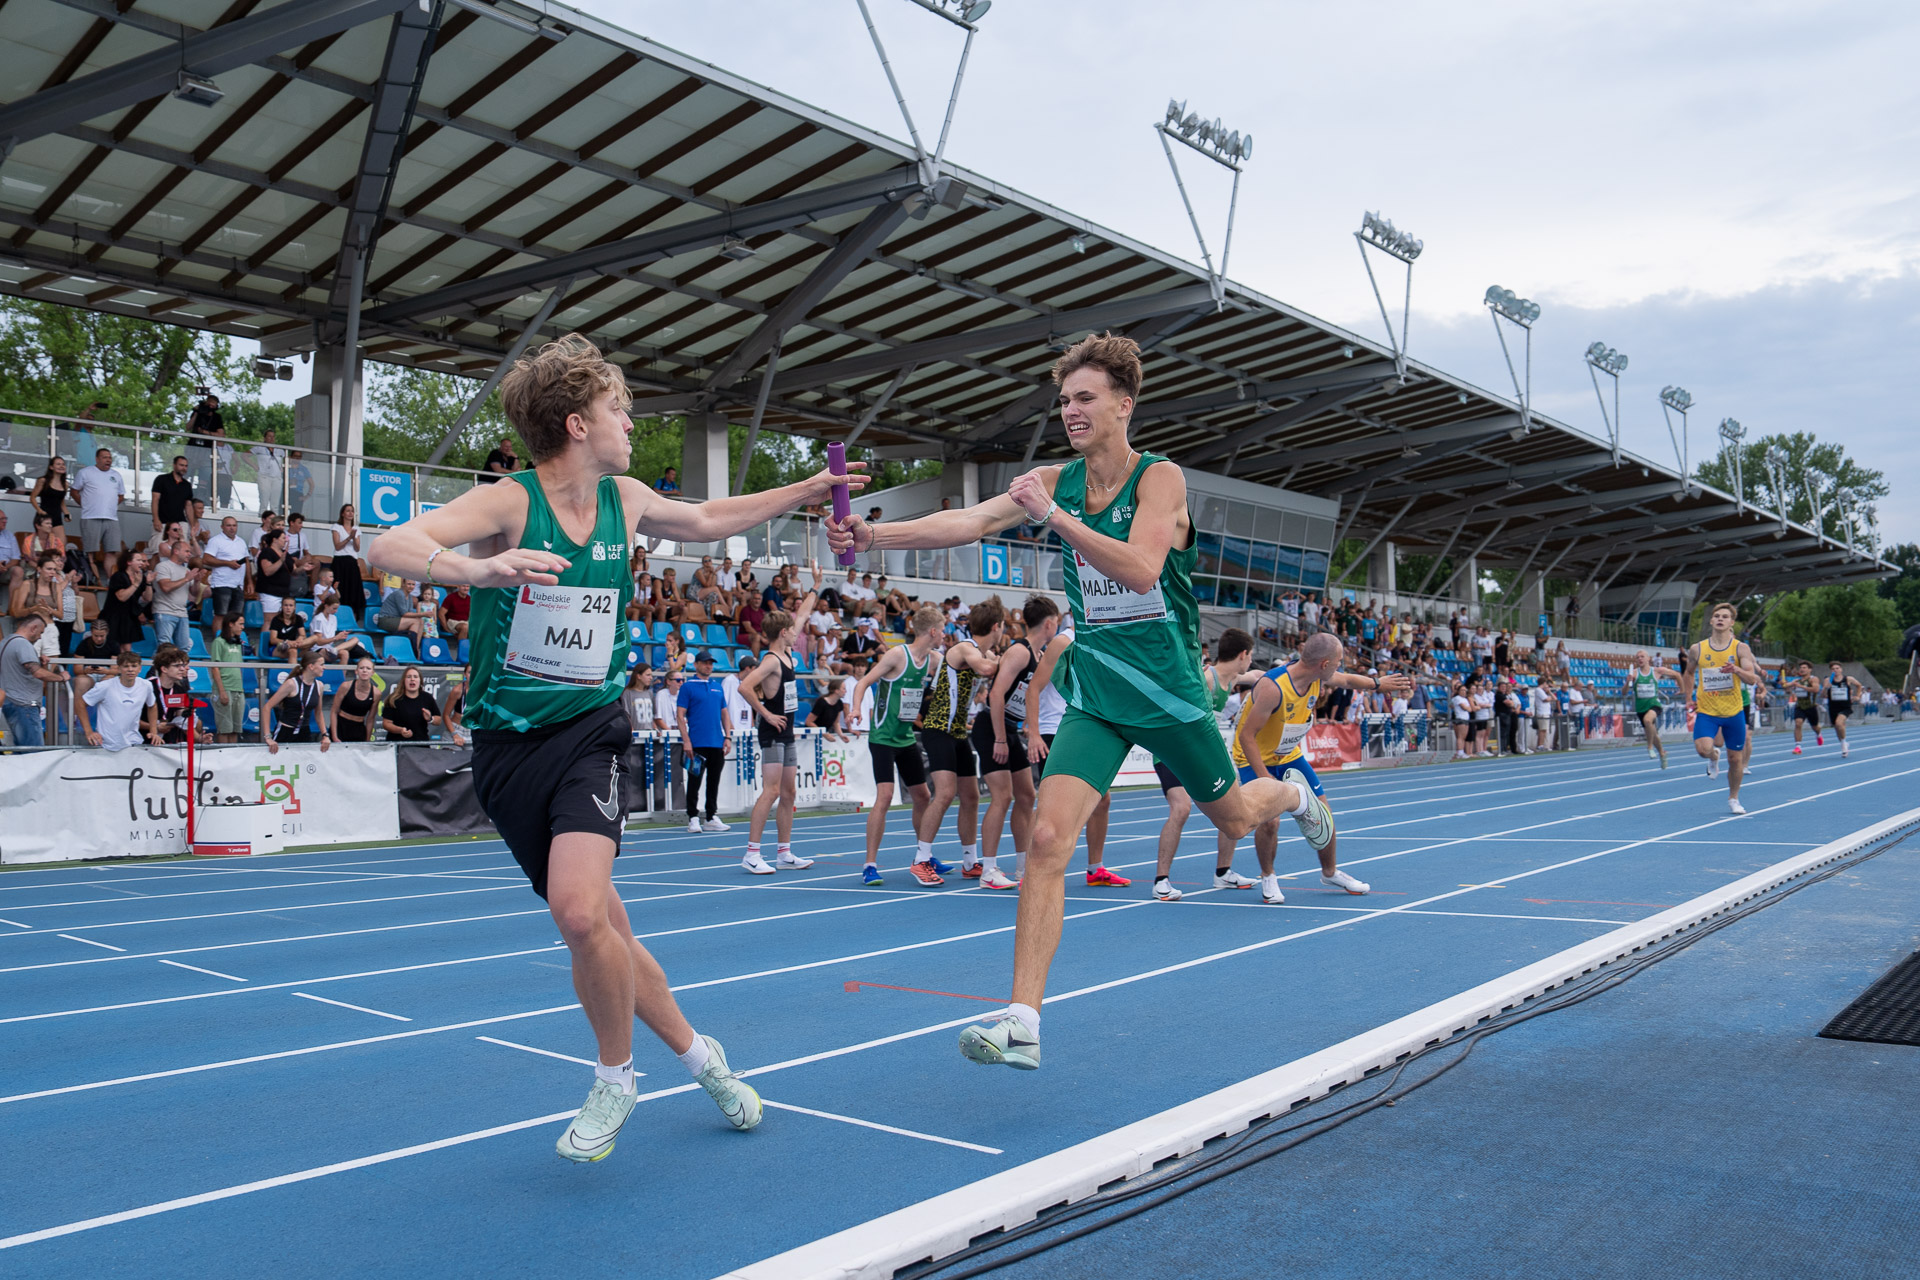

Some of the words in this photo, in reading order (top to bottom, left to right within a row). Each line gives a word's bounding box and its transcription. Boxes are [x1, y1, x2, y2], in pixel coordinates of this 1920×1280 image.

[369, 473, 401, 485] SEKTOR
[372, 485, 400, 522] C
[987, 555, 1003, 580] D
[1082, 578, 1157, 597] MAJEW
[533, 591, 571, 604] lubelskie
[580, 594, 611, 614] 242
[544, 626, 594, 650] MAJ
[522, 653, 562, 668] LUBELSKIE
[130, 828, 185, 841] MIAST
